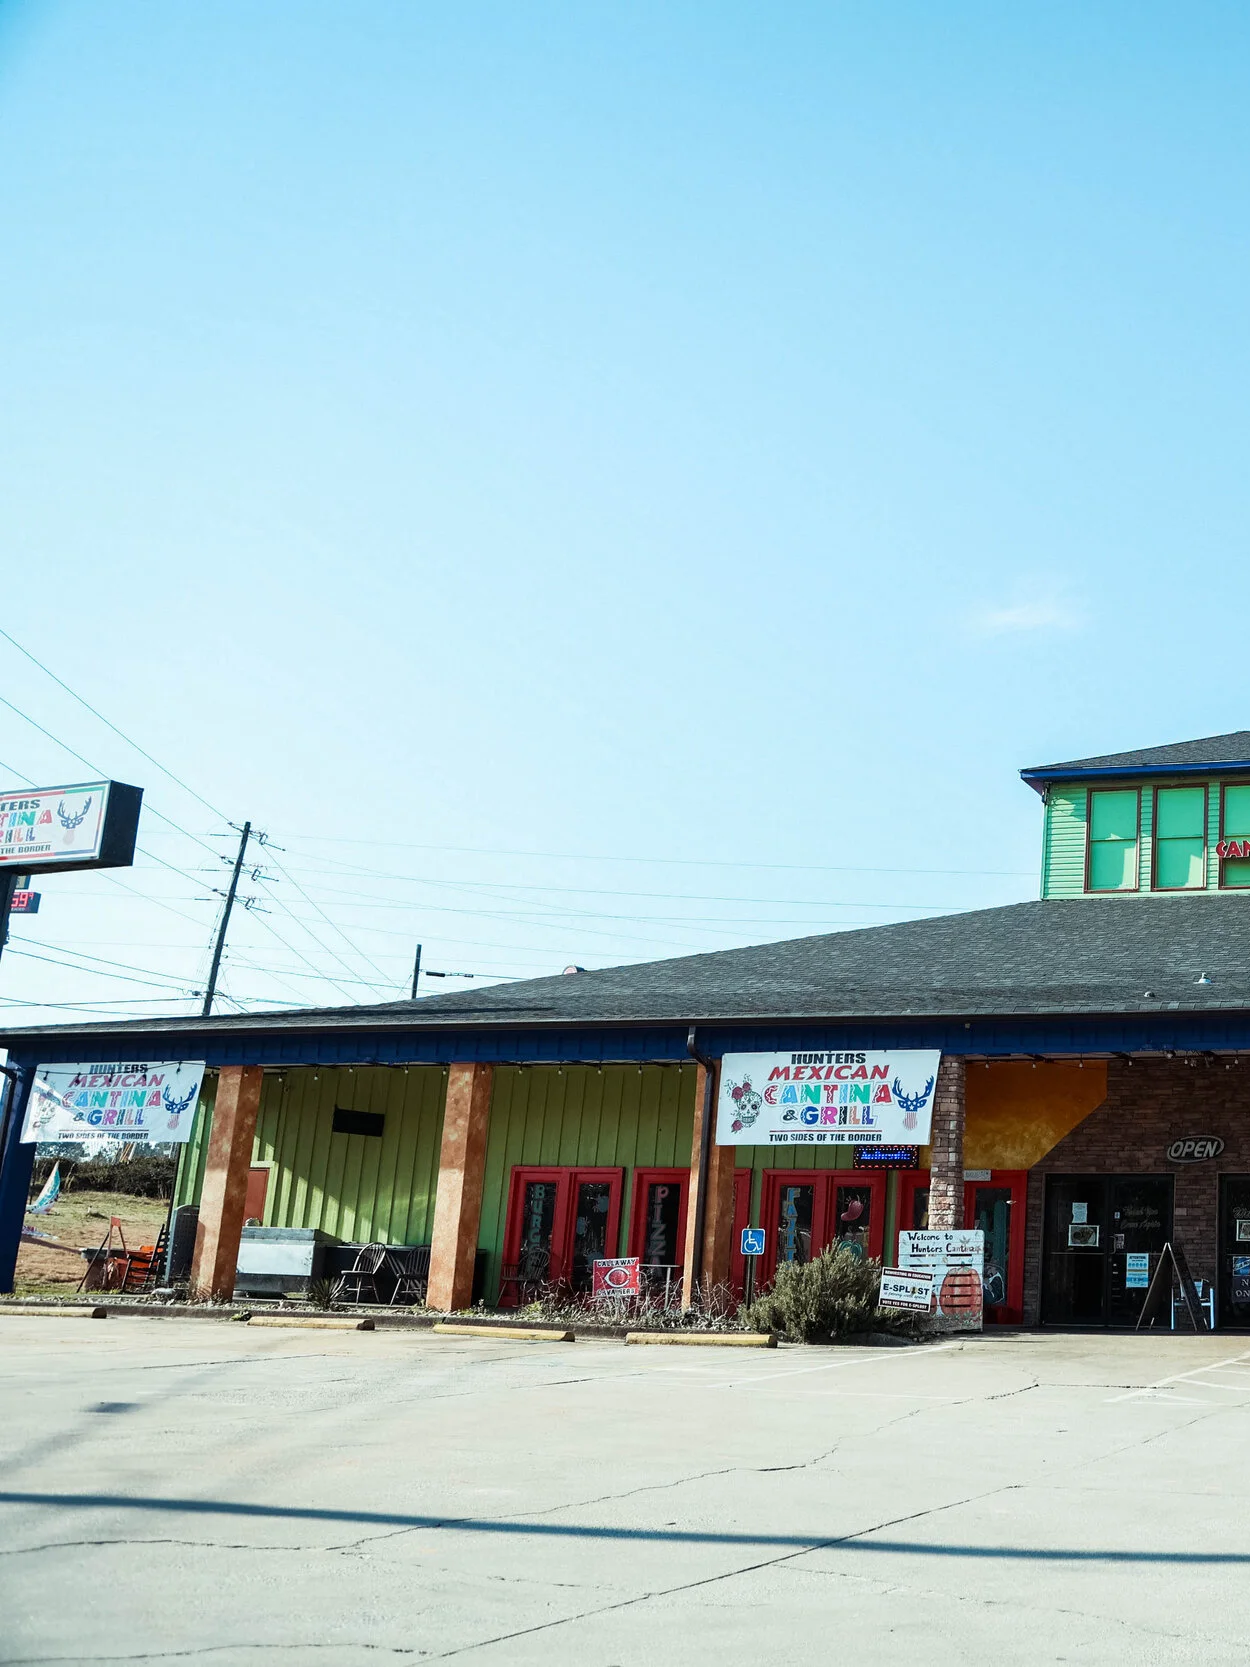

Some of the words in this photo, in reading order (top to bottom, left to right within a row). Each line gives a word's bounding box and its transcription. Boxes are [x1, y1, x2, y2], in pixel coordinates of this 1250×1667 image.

[18, 845, 51, 853] BORDER
[791, 1053, 866, 1065] HUNTERS
[89, 1063, 148, 1075] HUNTERS
[768, 1065, 890, 1081] MEXICAN
[68, 1074, 165, 1088] MEXICAN
[62, 1090, 161, 1108] CANTINA
[764, 1084, 892, 1104] CANTINA
[73, 1112, 85, 1121] &
[87, 1109, 144, 1126] GRILL
[782, 1109, 798, 1121] &
[801, 1106, 874, 1125] GRILL
[121, 1132, 149, 1140] BORDER
[830, 1133, 846, 1141] THE
[848, 1133, 882, 1141] BORDER
[1171, 1141, 1218, 1157] OPEN
[907, 1232, 940, 1240] Welcome
[911, 1243, 943, 1253] Hunters
[597, 1259, 636, 1267] CALLAWAY
[883, 1284, 930, 1295] E-SPLST
